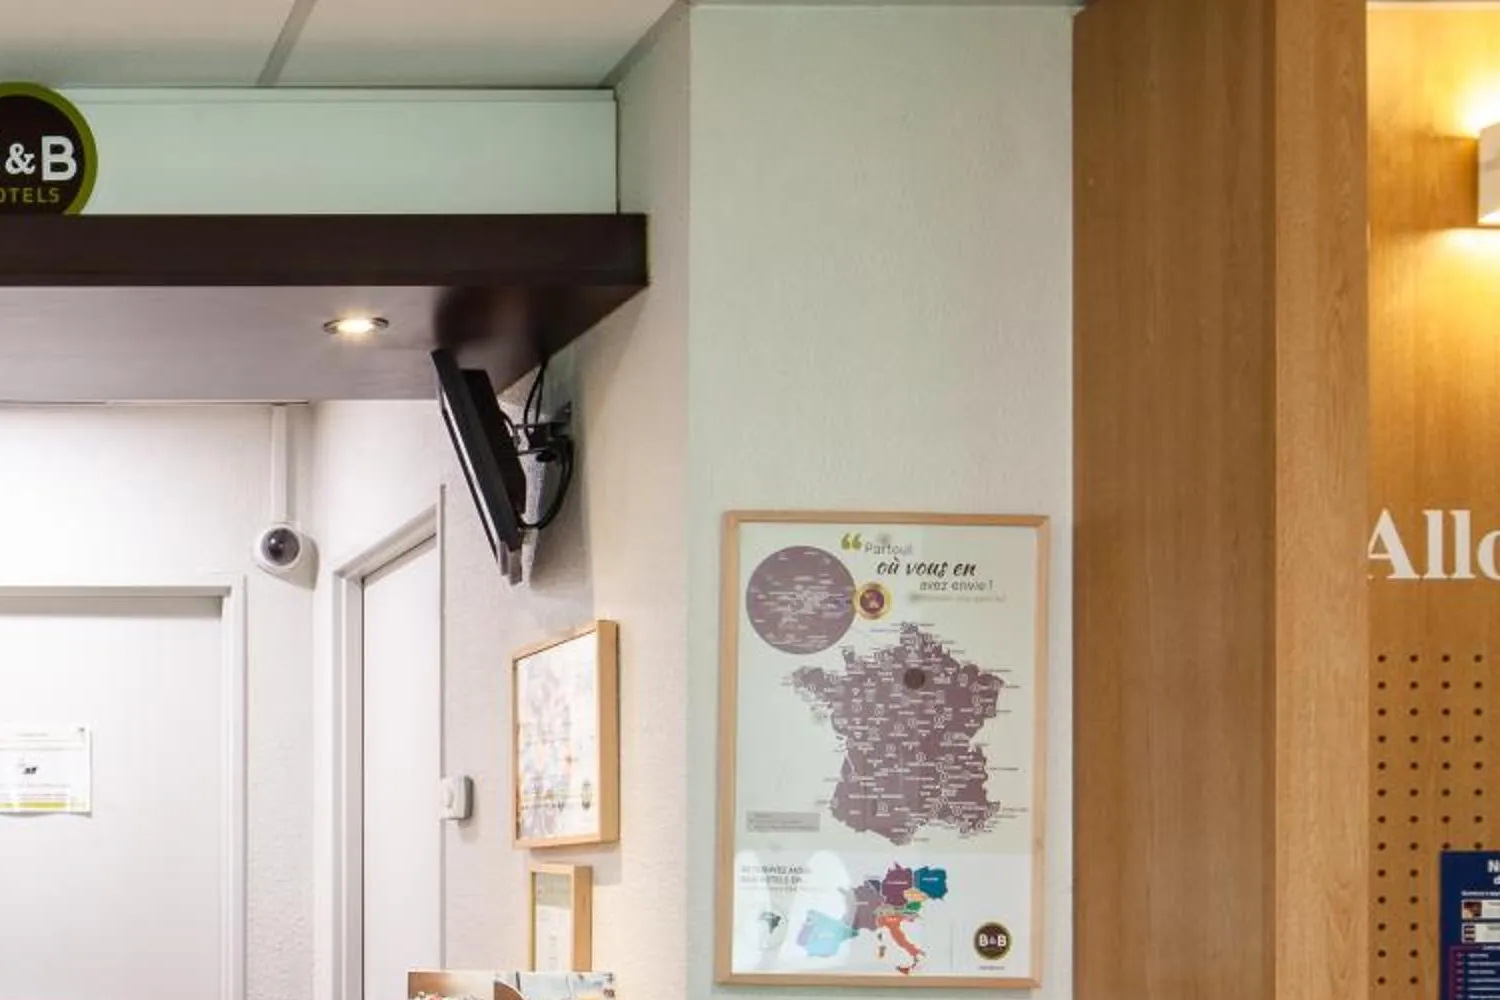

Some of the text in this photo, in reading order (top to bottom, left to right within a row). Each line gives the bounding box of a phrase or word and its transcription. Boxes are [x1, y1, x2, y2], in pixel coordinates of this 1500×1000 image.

[876, 556, 978, 578] où vous en
